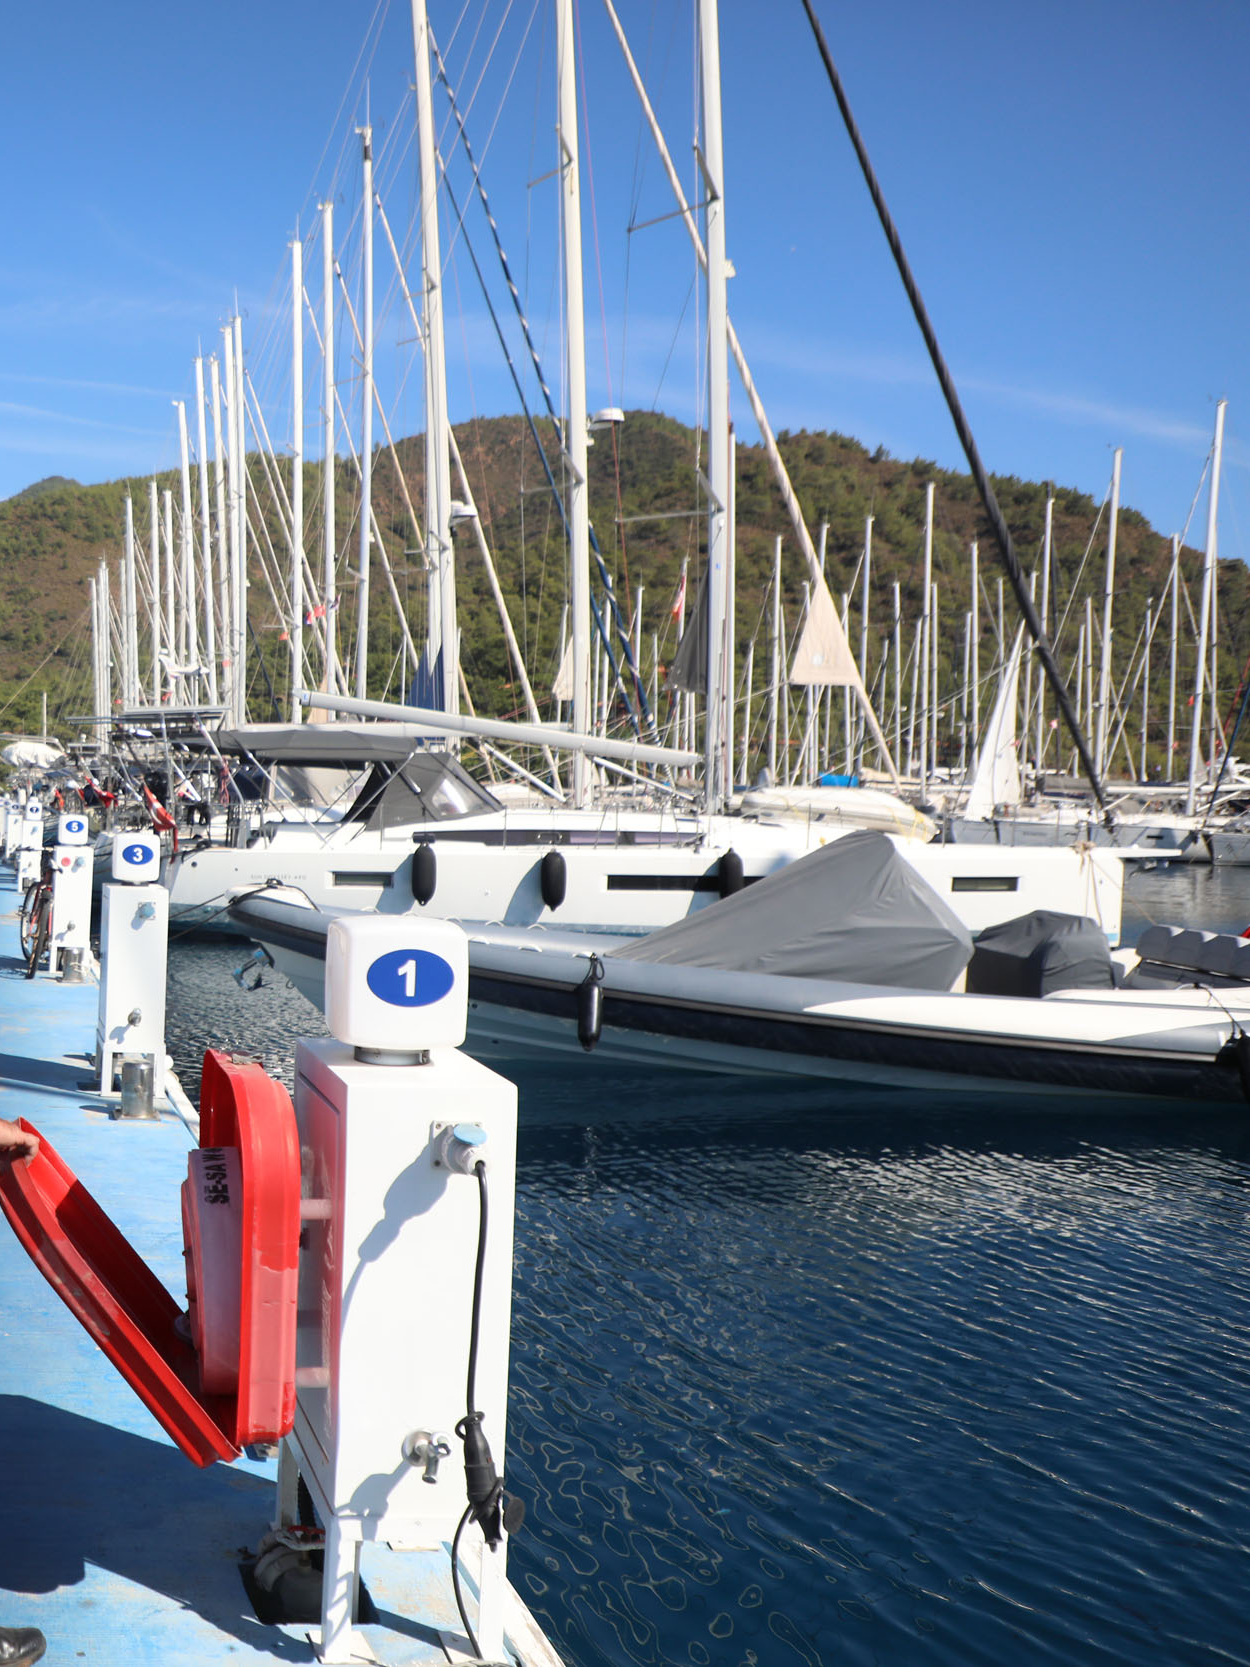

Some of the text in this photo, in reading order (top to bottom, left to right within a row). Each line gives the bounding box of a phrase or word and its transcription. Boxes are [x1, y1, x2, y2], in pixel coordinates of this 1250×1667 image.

[72, 822, 79, 832] 5
[133, 848, 143, 862] 3
[397, 959, 416, 997] 1
